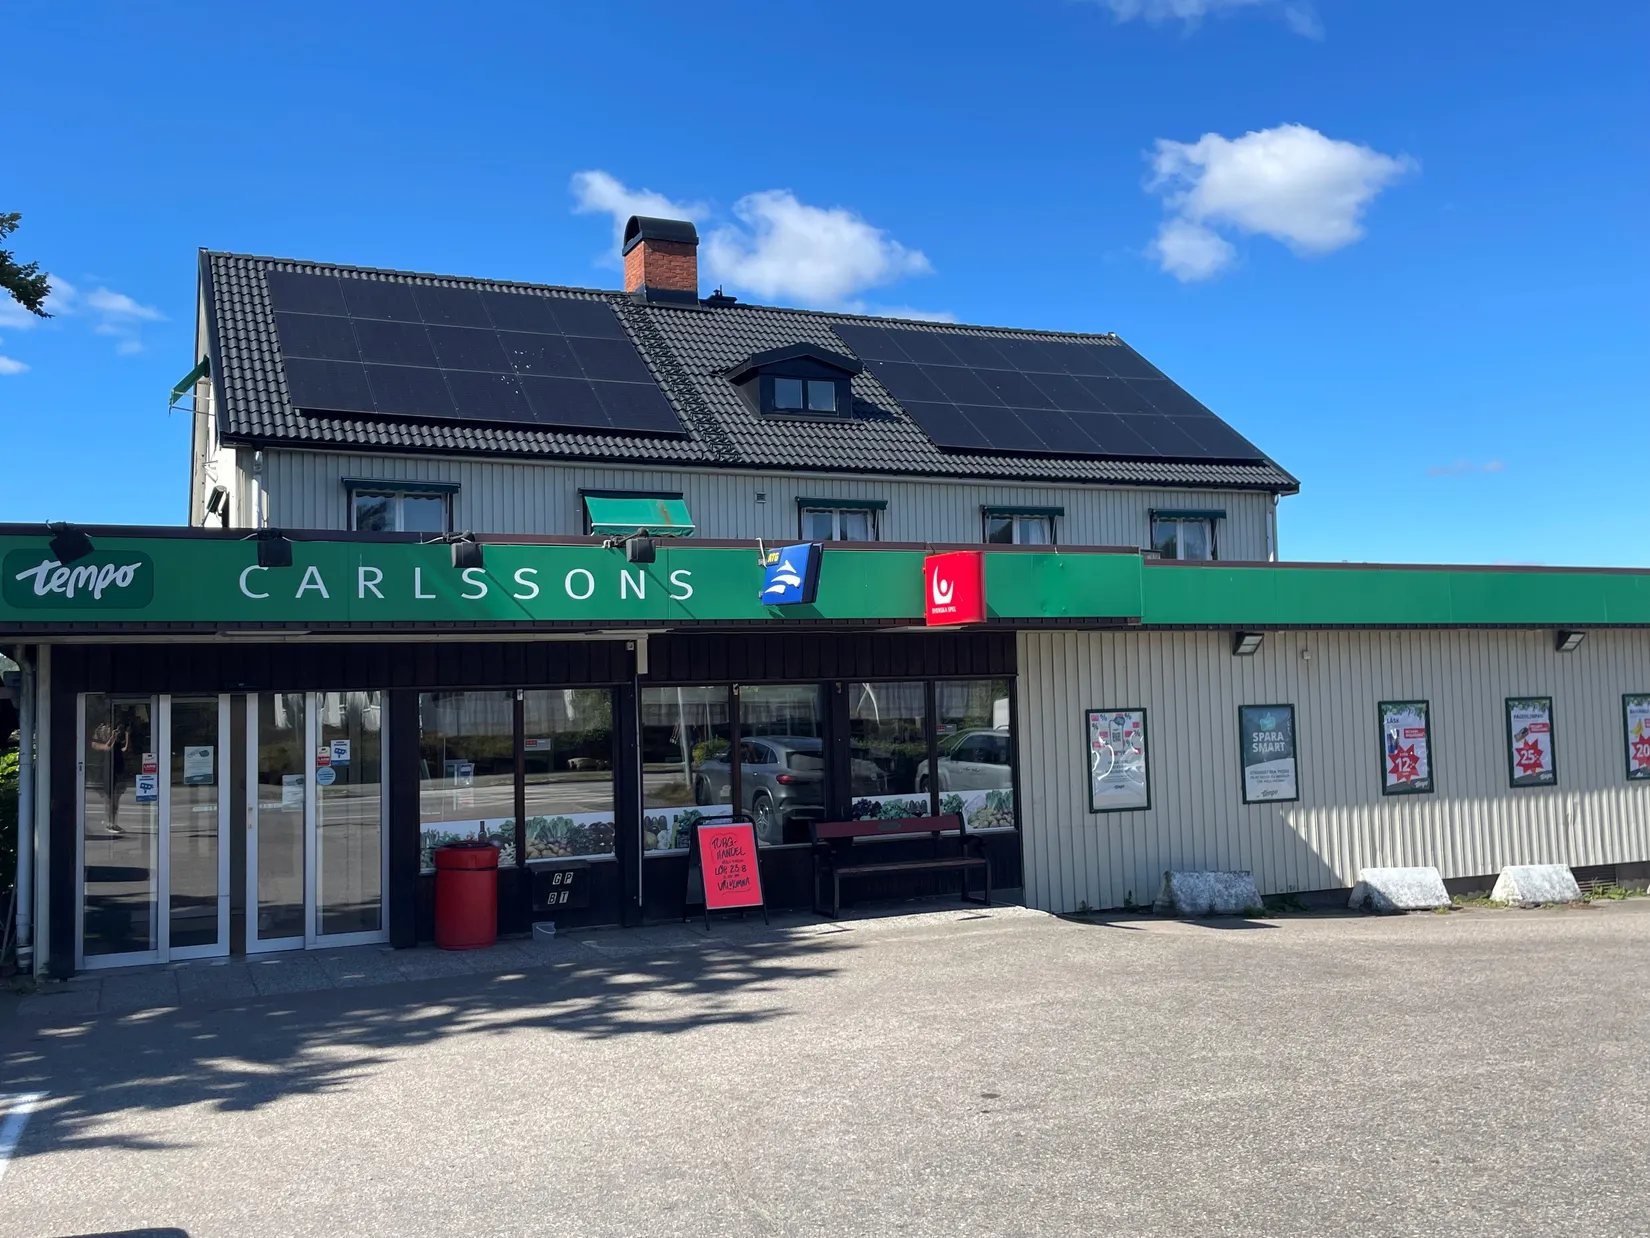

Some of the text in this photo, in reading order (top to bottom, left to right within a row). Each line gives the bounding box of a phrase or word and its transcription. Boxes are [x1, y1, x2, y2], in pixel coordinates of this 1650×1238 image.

[767, 552, 780, 563] ATG
[16, 560, 142, 600] tempo
[239, 566, 694, 600] CARLSSONS
[1252, 731, 1284, 742] SPARA
[1252, 742, 1285, 753] SMART
[1636, 744, 1650, 758] 20
[716, 847, 746, 860] HANDEL
